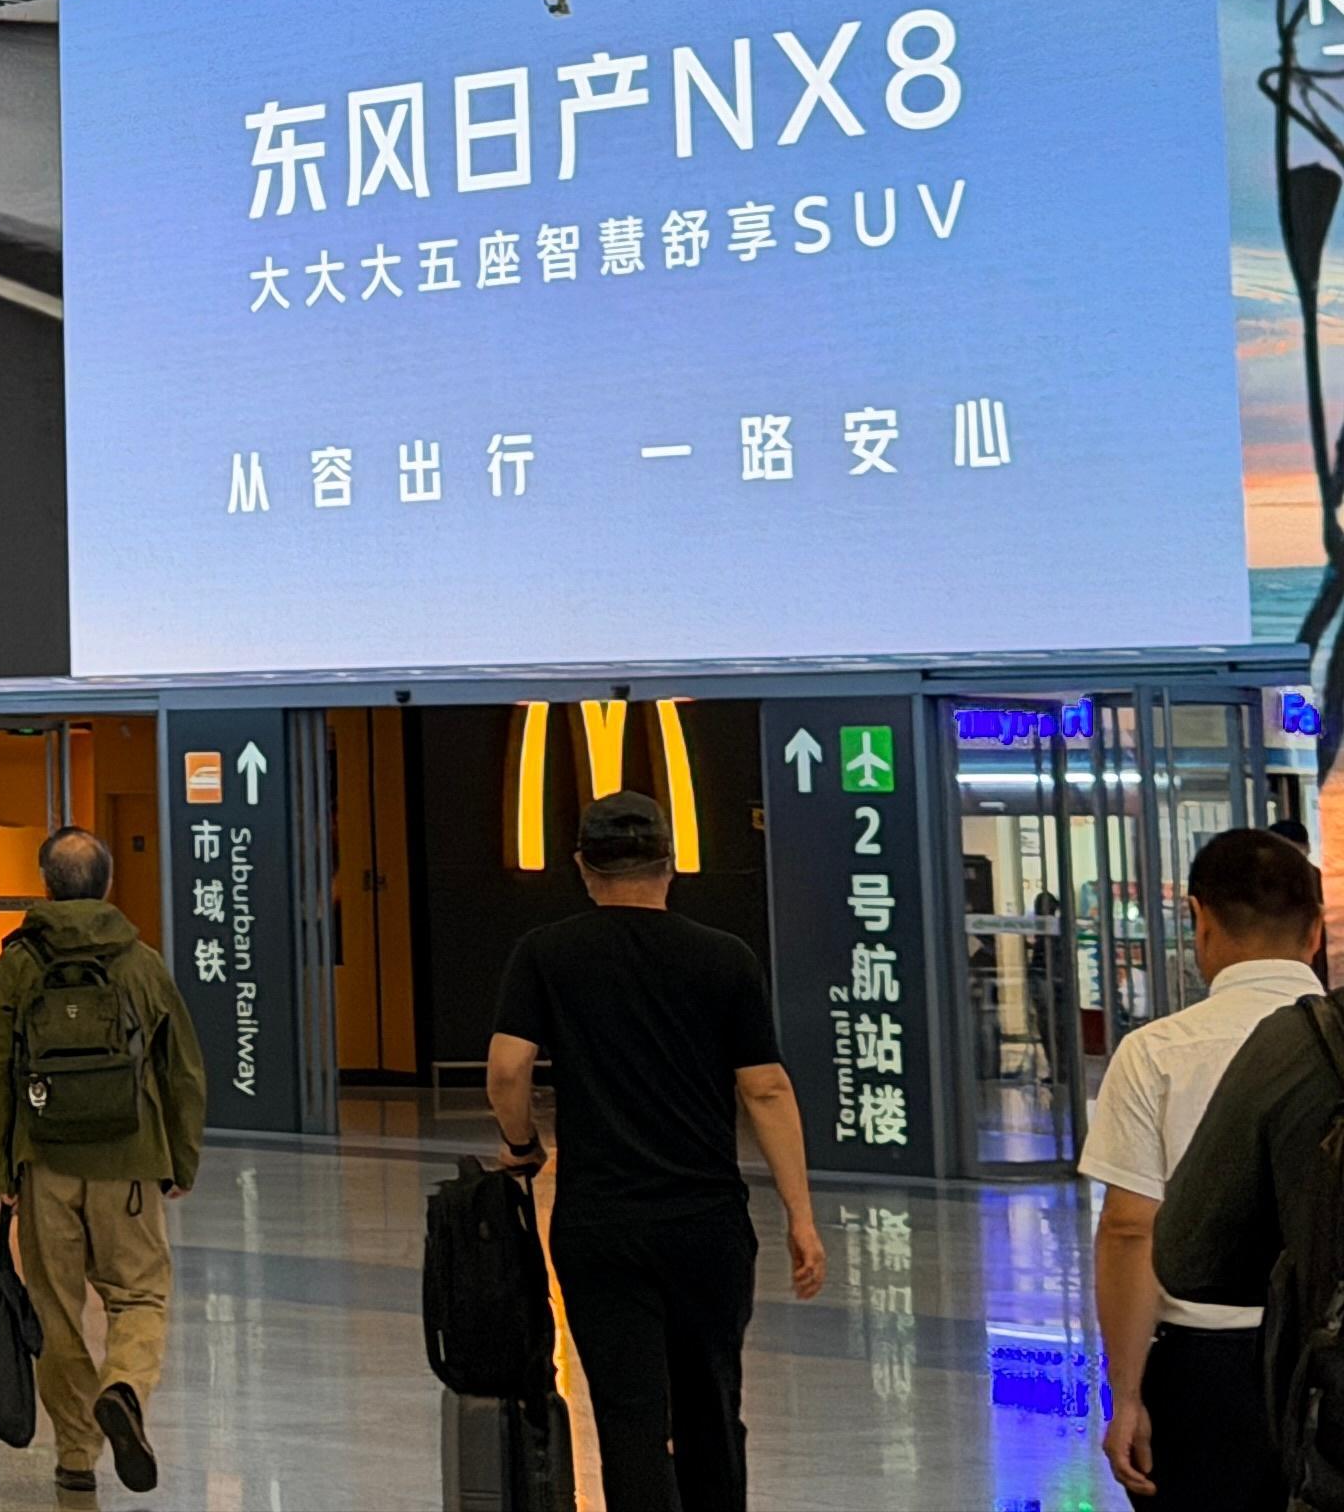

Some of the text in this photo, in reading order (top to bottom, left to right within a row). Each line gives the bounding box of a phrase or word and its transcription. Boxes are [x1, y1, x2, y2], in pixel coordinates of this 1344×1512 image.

[244, 9, 964, 220] 东风日产NX8
[249, 179, 967, 313] 大大大五座智慧舒享SUV
[226, 397, 1012, 515] 从容出行 一路安心
[190, 819, 226, 982] 市域铁
[230, 827, 259, 1096] Suburban Railway
[847, 806, 907, 1145] 2号航站楼
[829, 985, 857, 1142] Terminal 2
